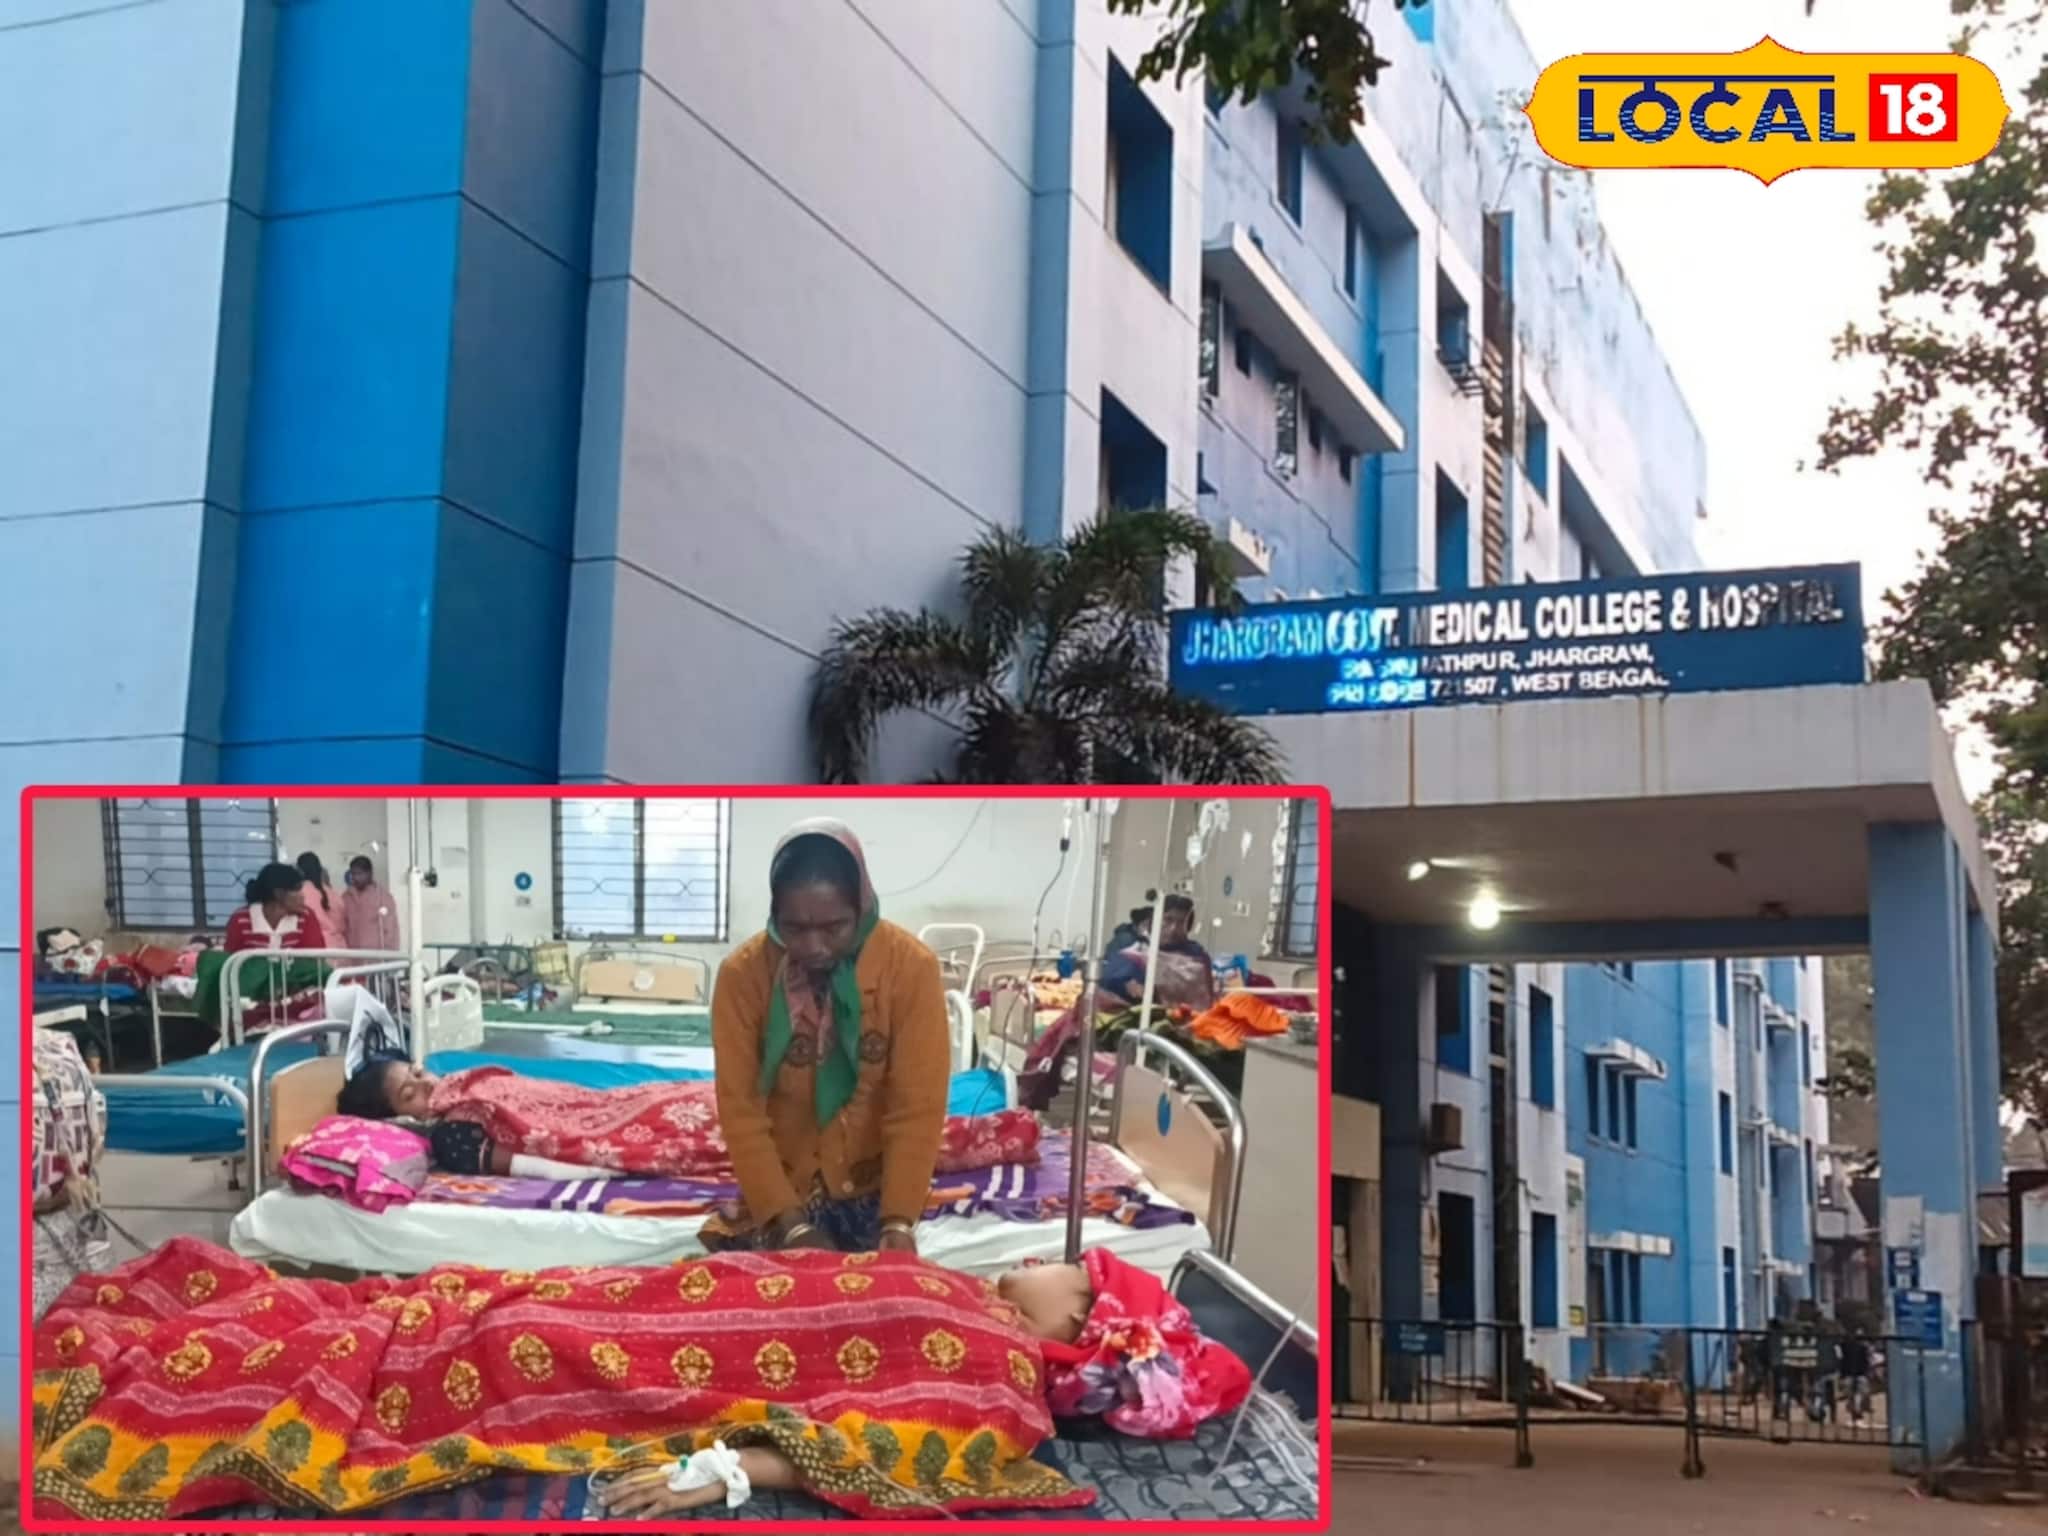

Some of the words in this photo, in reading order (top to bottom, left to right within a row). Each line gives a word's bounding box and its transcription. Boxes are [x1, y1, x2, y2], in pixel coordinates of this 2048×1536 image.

[1408, 597, 1529, 648] MEDICAL
[1535, 589, 1663, 640] COLLEGE
[1669, 586, 1691, 632] &
[1510, 671, 1573, 694] WEST
[1578, 666, 1670, 690] BENGAL
